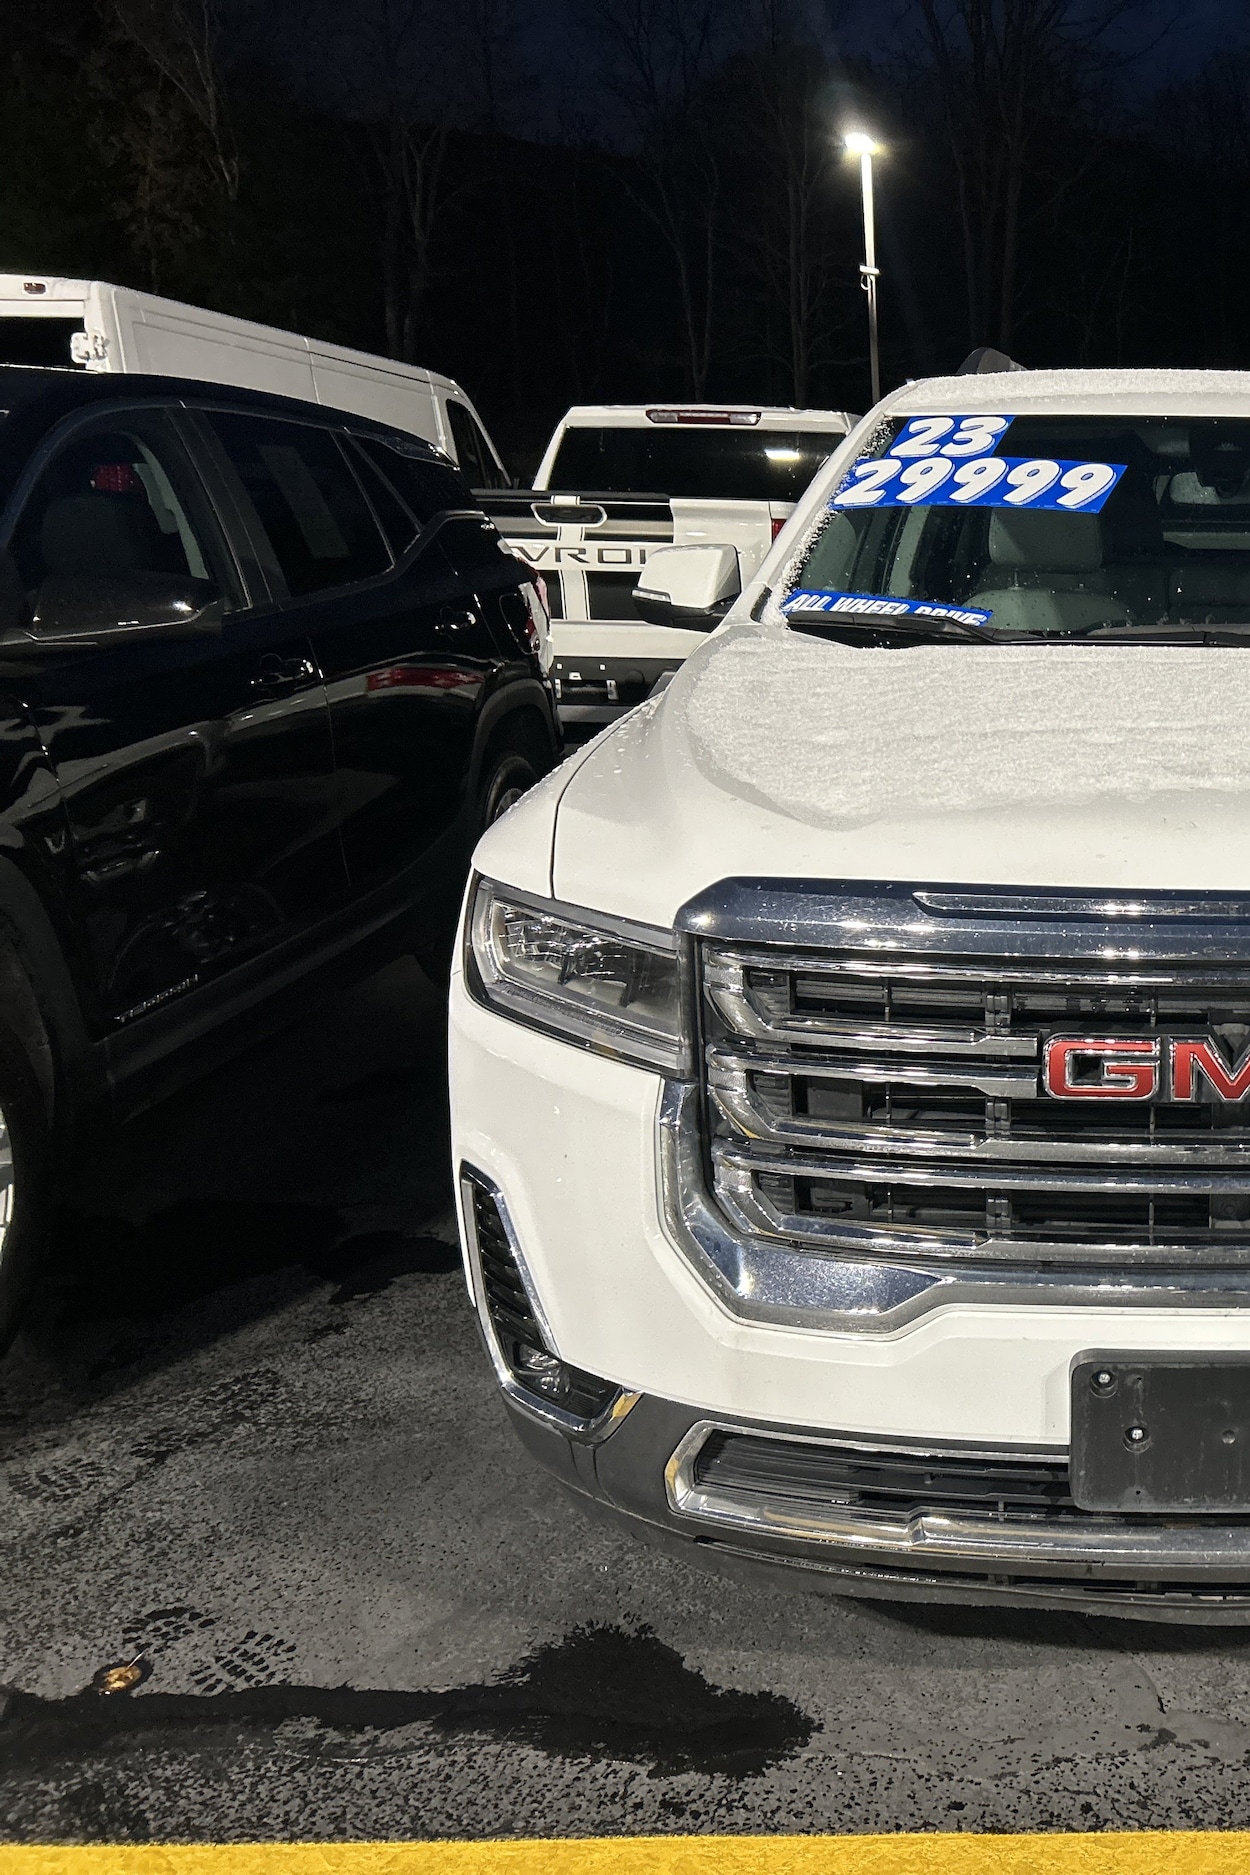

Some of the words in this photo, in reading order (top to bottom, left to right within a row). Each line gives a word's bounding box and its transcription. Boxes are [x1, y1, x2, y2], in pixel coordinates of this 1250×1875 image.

[889, 416, 1010, 458] 23
[833, 457, 1117, 508] 29999
[783, 593, 832, 612] ALL
